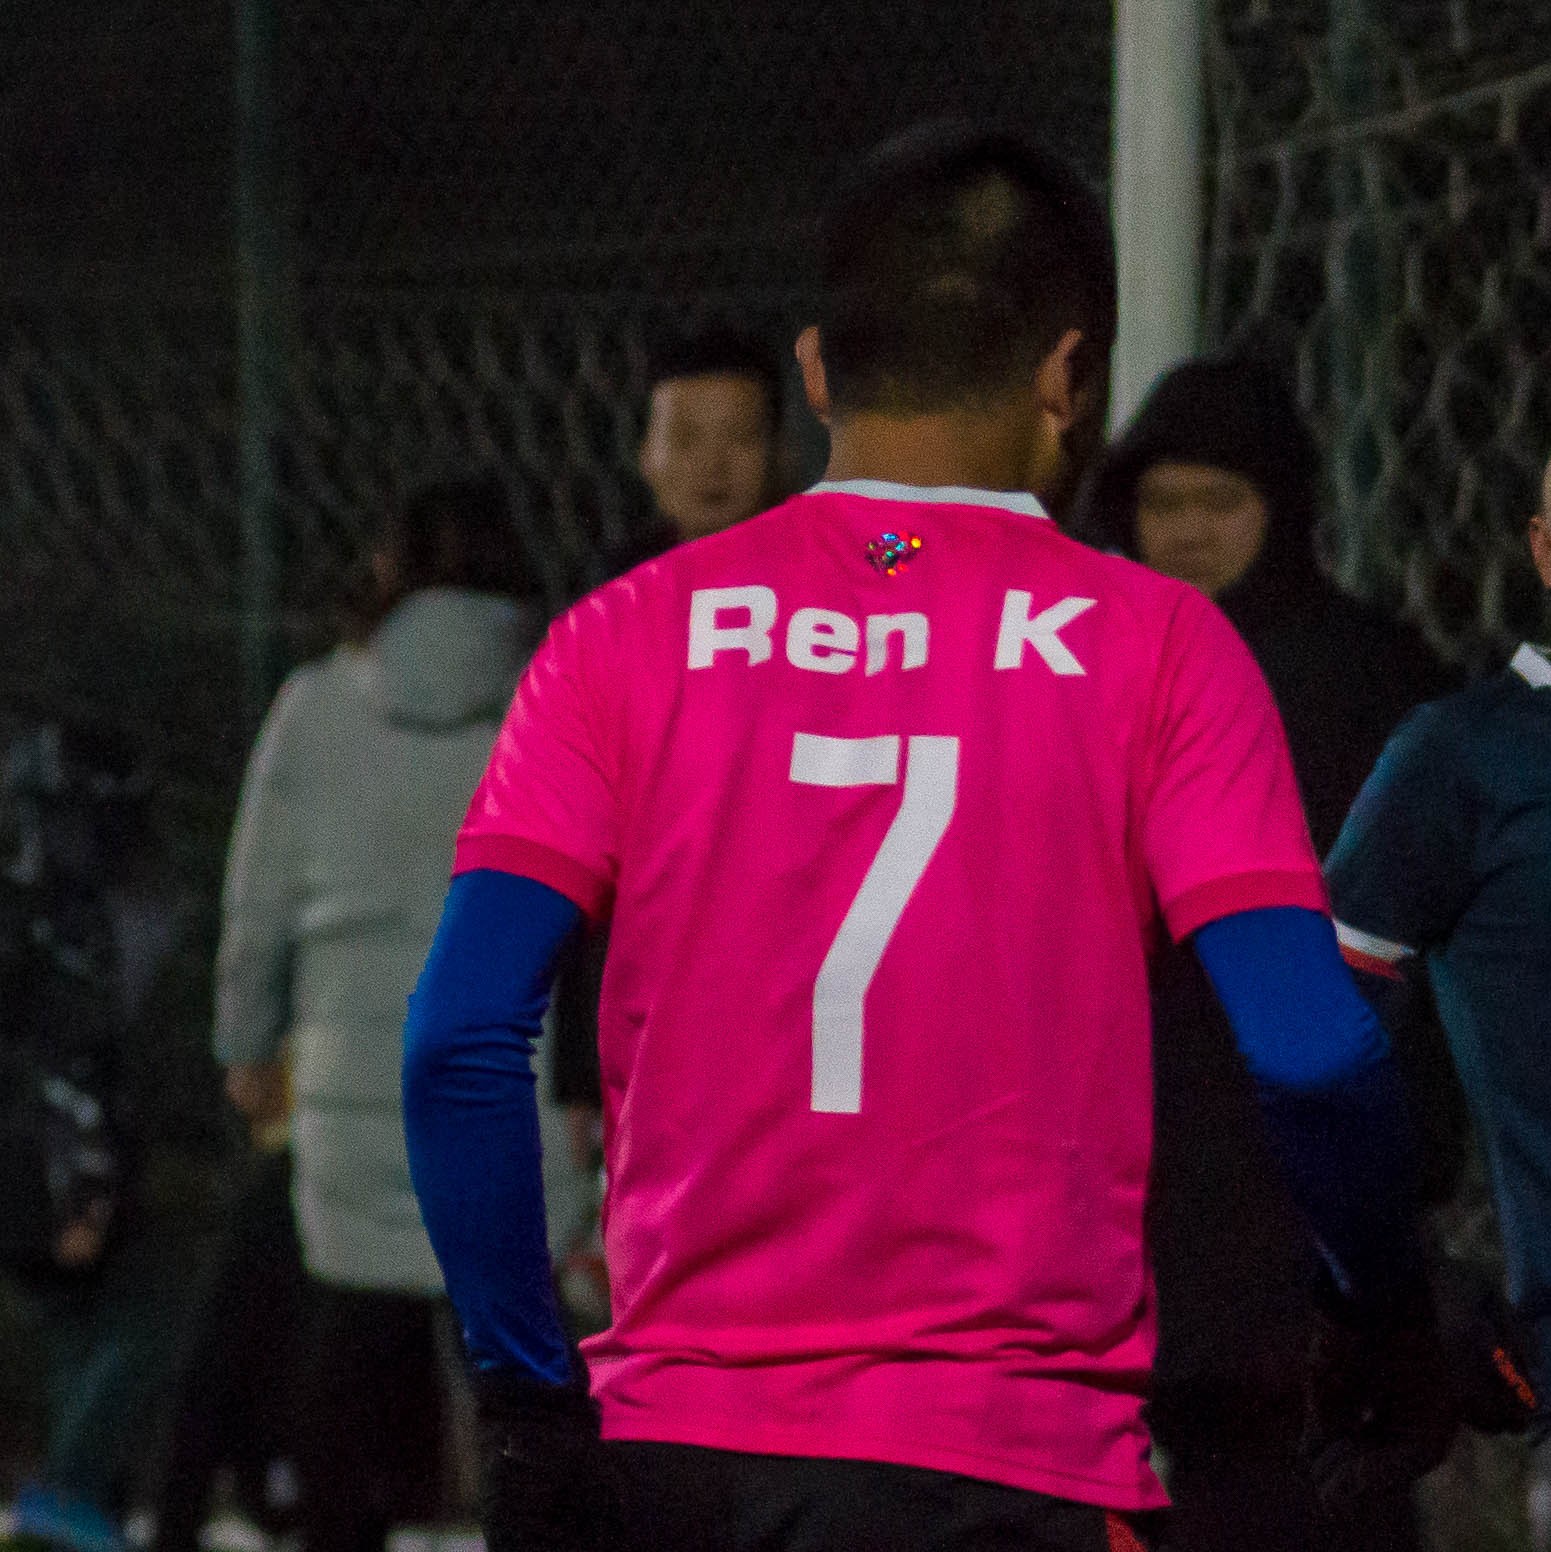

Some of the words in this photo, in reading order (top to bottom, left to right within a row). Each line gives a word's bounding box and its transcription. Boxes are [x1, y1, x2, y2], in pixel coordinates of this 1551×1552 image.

[687, 585, 931, 676] Ren
[993, 588, 1099, 676] K
[788, 730, 961, 1114] 7
